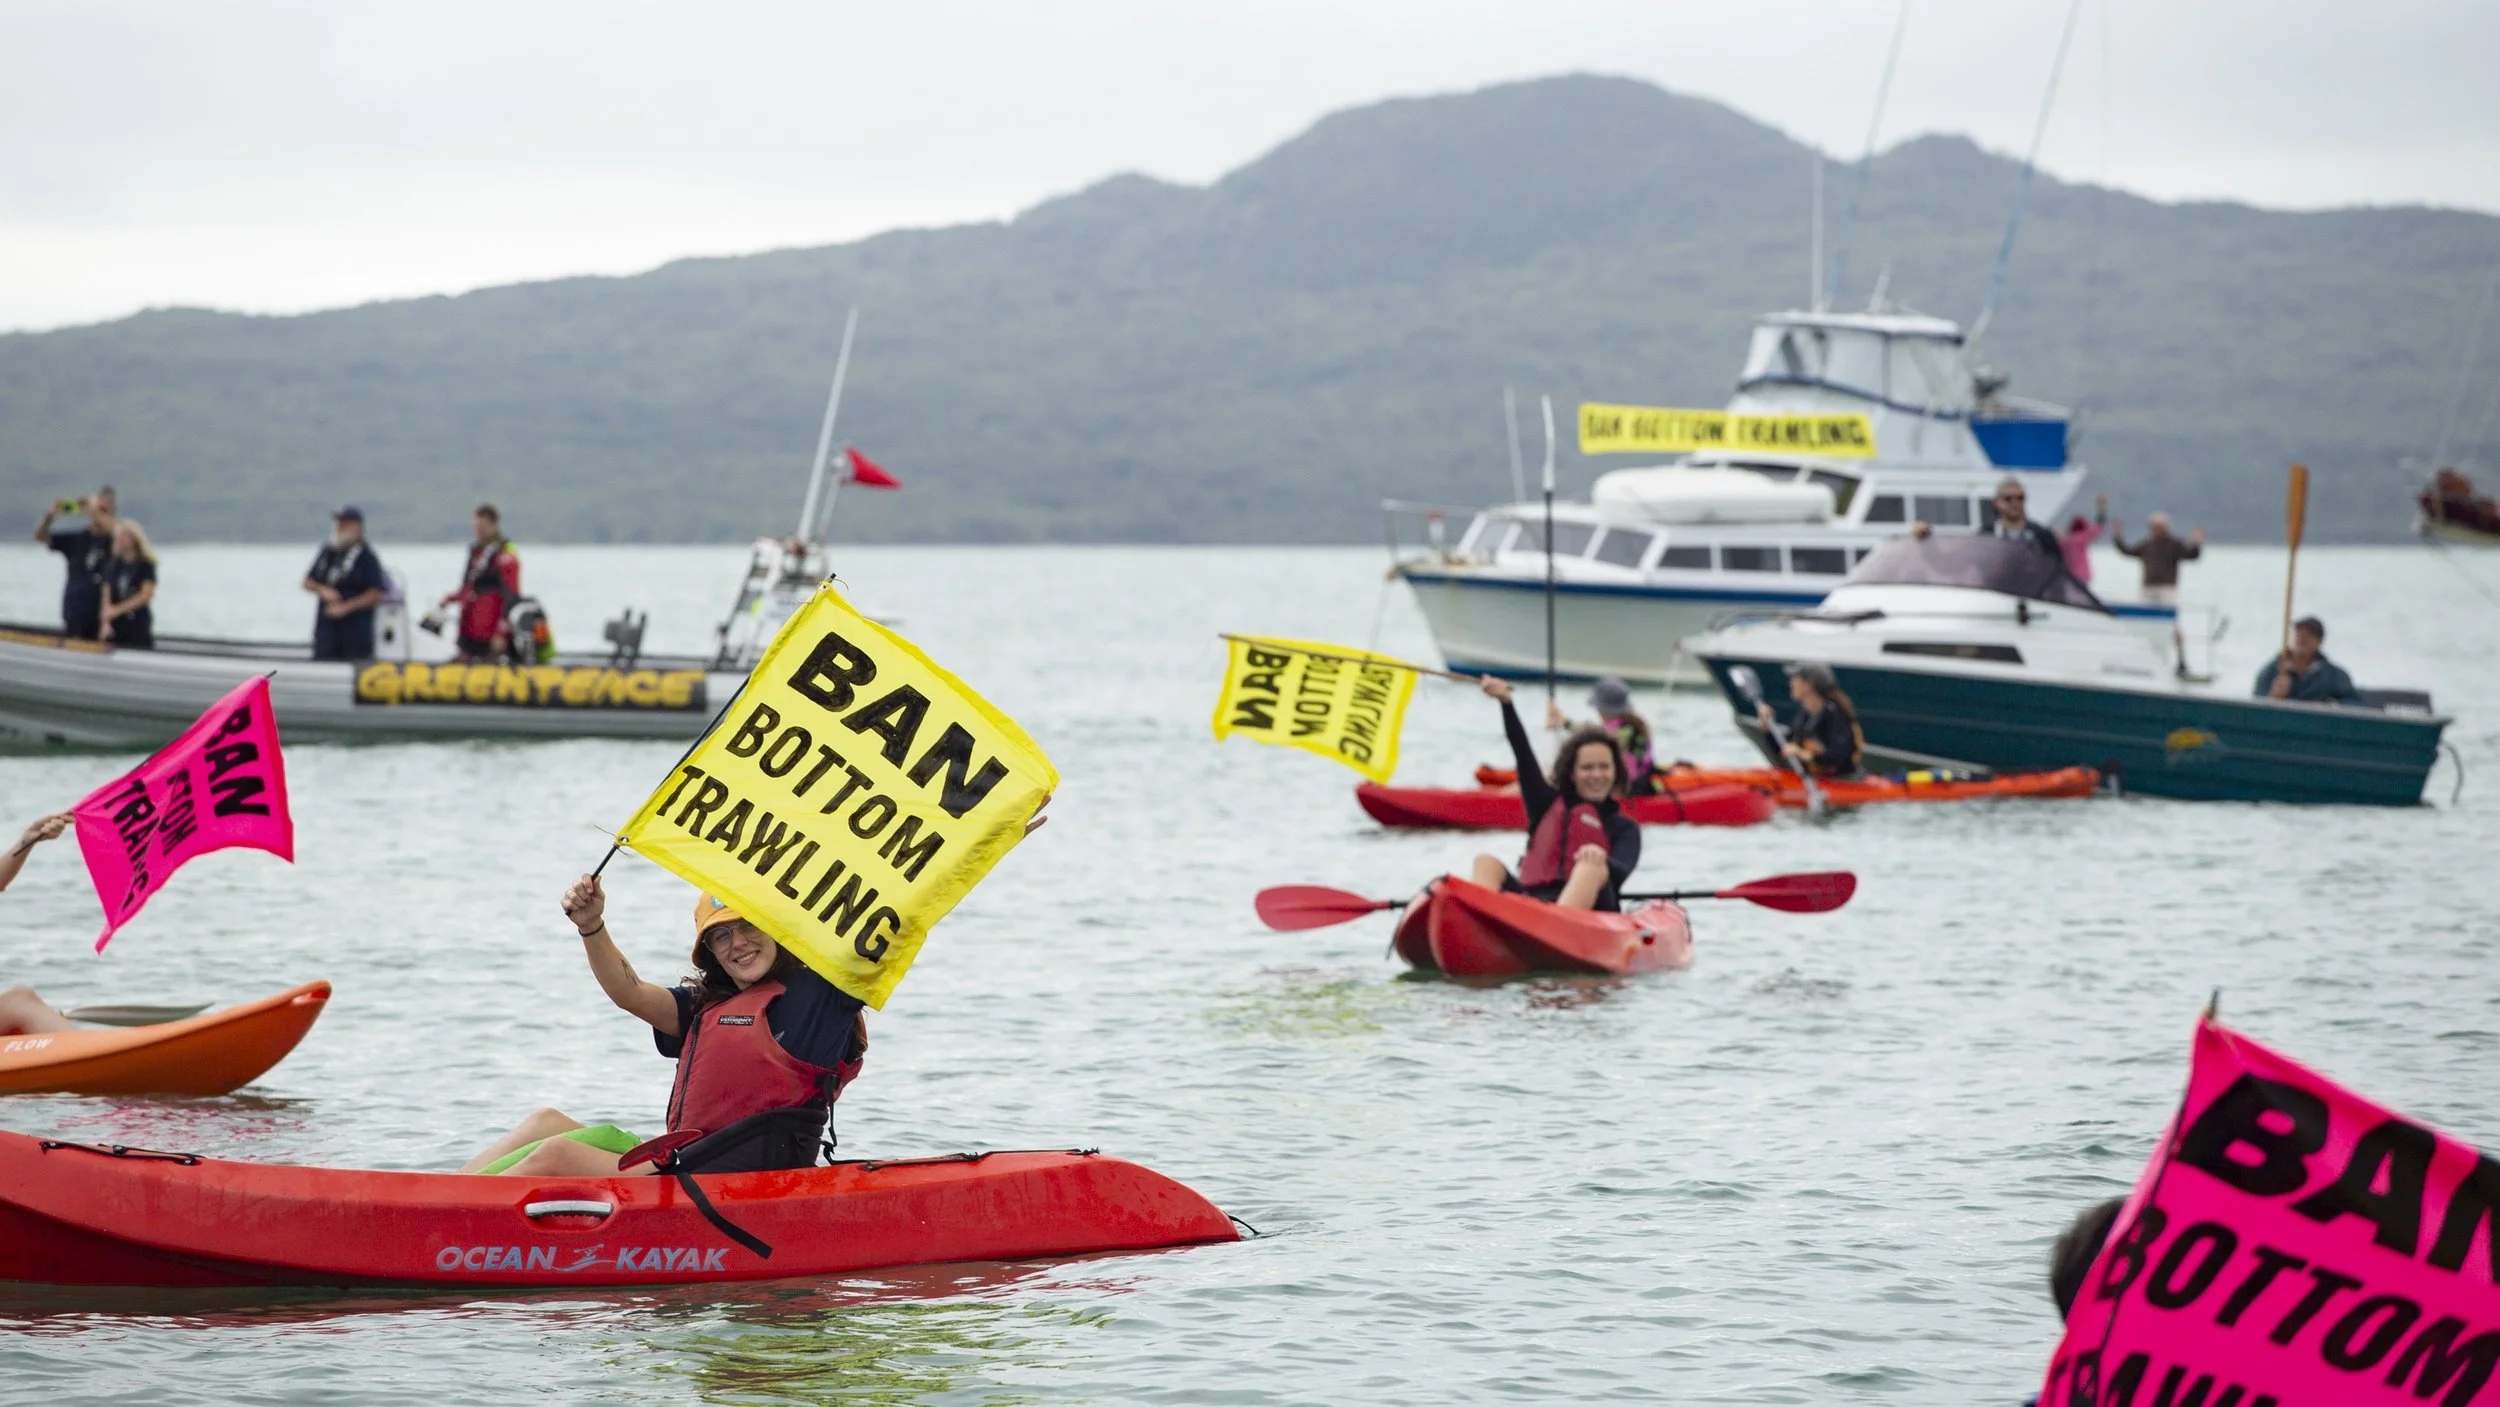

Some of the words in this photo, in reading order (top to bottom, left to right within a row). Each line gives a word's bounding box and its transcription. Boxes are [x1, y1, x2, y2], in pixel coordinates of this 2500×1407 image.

[357, 661, 706, 707] GREENPEACE
[787, 631, 1010, 819] BAN
[204, 704, 271, 818] BAN
[724, 702, 946, 883] BOTTOM
[655, 764, 903, 964] TRAWLING
[4, 1038, 54, 1053] FLOW
[435, 1245, 558, 1272] OCEAN
[615, 1247, 731, 1272] KAYAK
